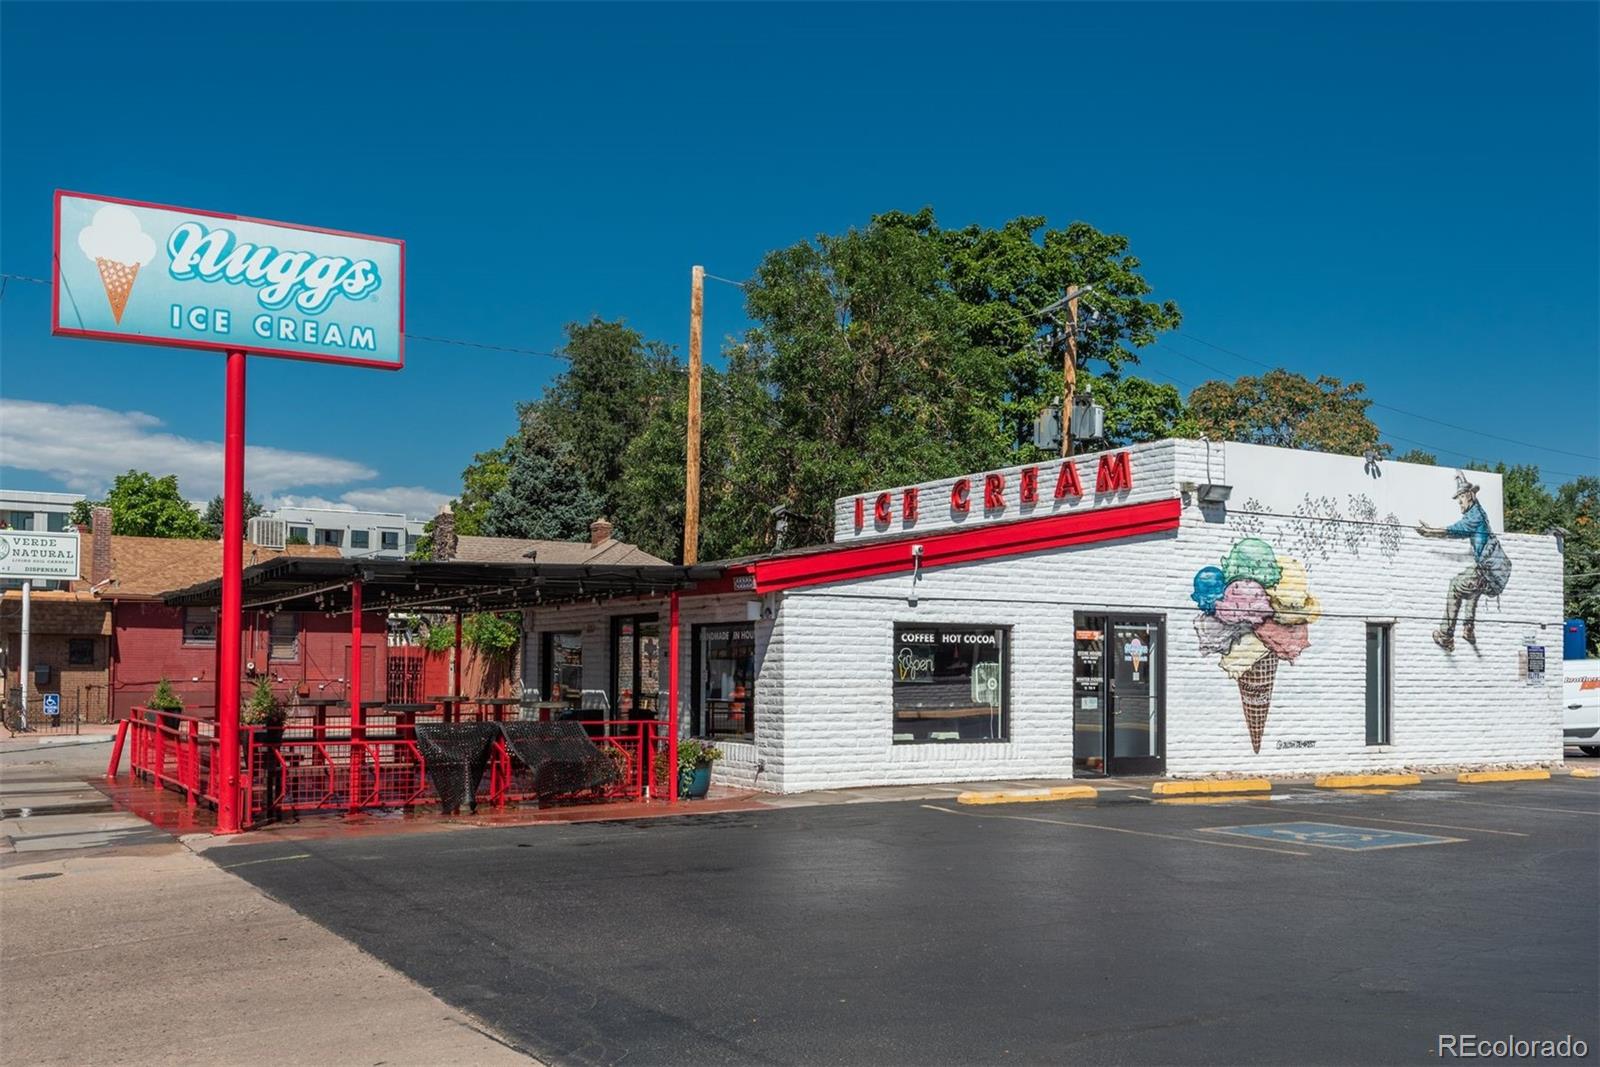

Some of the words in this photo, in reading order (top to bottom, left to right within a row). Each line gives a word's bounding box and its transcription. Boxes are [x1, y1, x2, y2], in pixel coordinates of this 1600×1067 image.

[168, 222, 381, 315] Nuggs
[171, 304, 230, 333] ICE
[254, 314, 376, 351] CREAM
[854, 487, 918, 529] ICE
[951, 451, 1133, 514] CREAM
[12, 548, 74, 559] NATURAL
[13, 537, 57, 547] VERDE
[901, 633, 935, 642] COFFEE
[942, 634, 961, 643] HOT
[964, 634, 996, 644] COCOA
